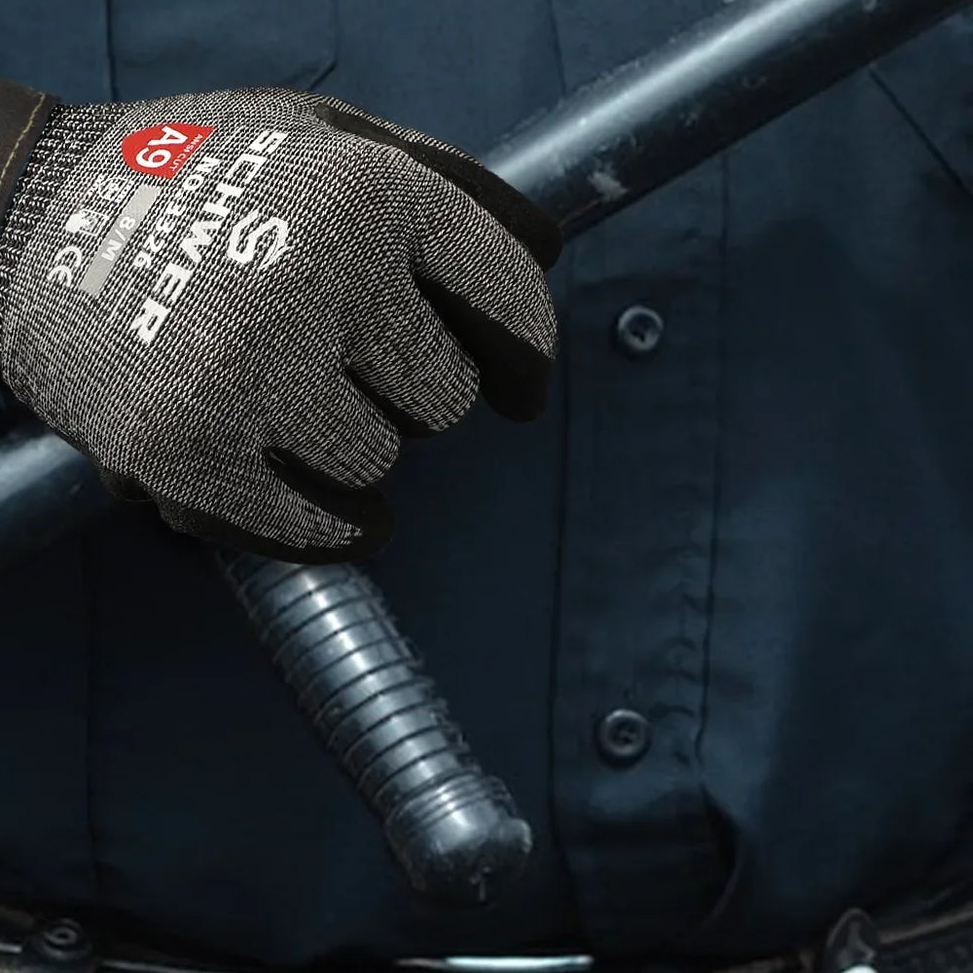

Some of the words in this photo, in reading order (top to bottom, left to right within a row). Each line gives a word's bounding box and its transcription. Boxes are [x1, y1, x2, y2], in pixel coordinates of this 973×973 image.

[136, 126, 188, 167] A9
[170, 152, 187, 171] CUT
[184, 134, 203, 153] ANSI
[101, 217, 136, 262] 8/M
[130, 130, 288, 345] SCHWER
